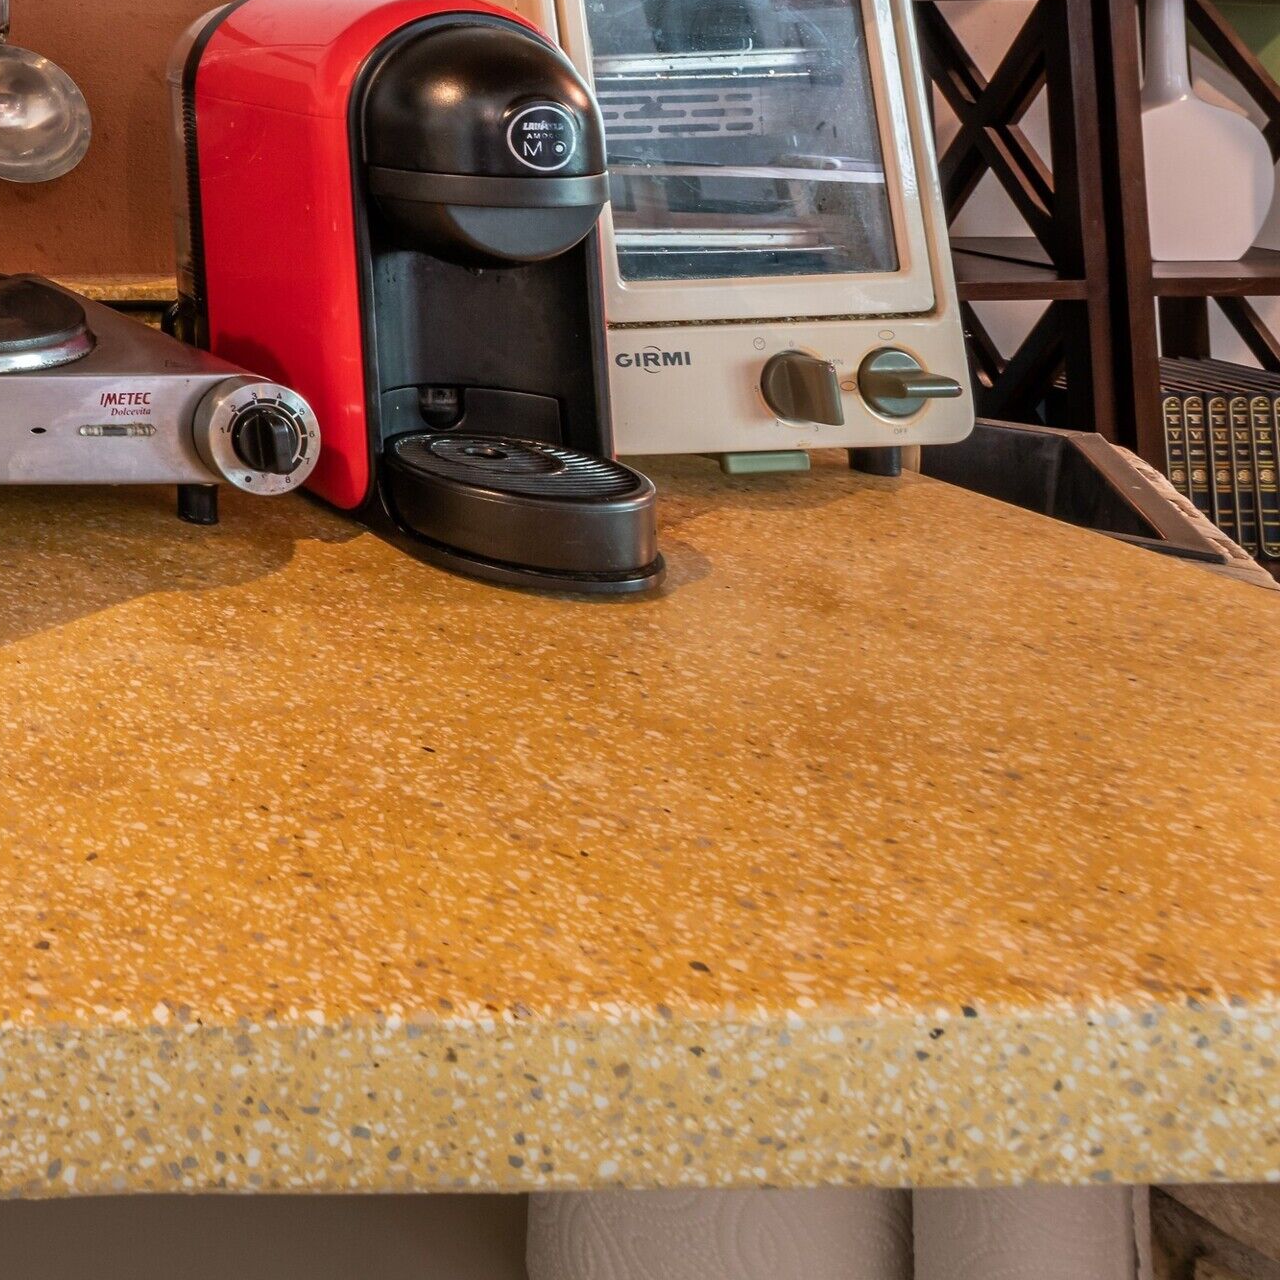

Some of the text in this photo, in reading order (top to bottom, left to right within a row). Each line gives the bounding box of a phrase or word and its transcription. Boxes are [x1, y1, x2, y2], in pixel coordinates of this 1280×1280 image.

[615, 351, 691, 367] GIRMI
[100, 392, 151, 407] IMETEC
[251, 392, 258, 400] 3
[111, 407, 151, 416] Dolcevita
[230, 404, 236, 412] 2
[299, 407, 305, 415] 5
[309, 430, 315, 438] 6
[305, 457, 311, 465] 7
